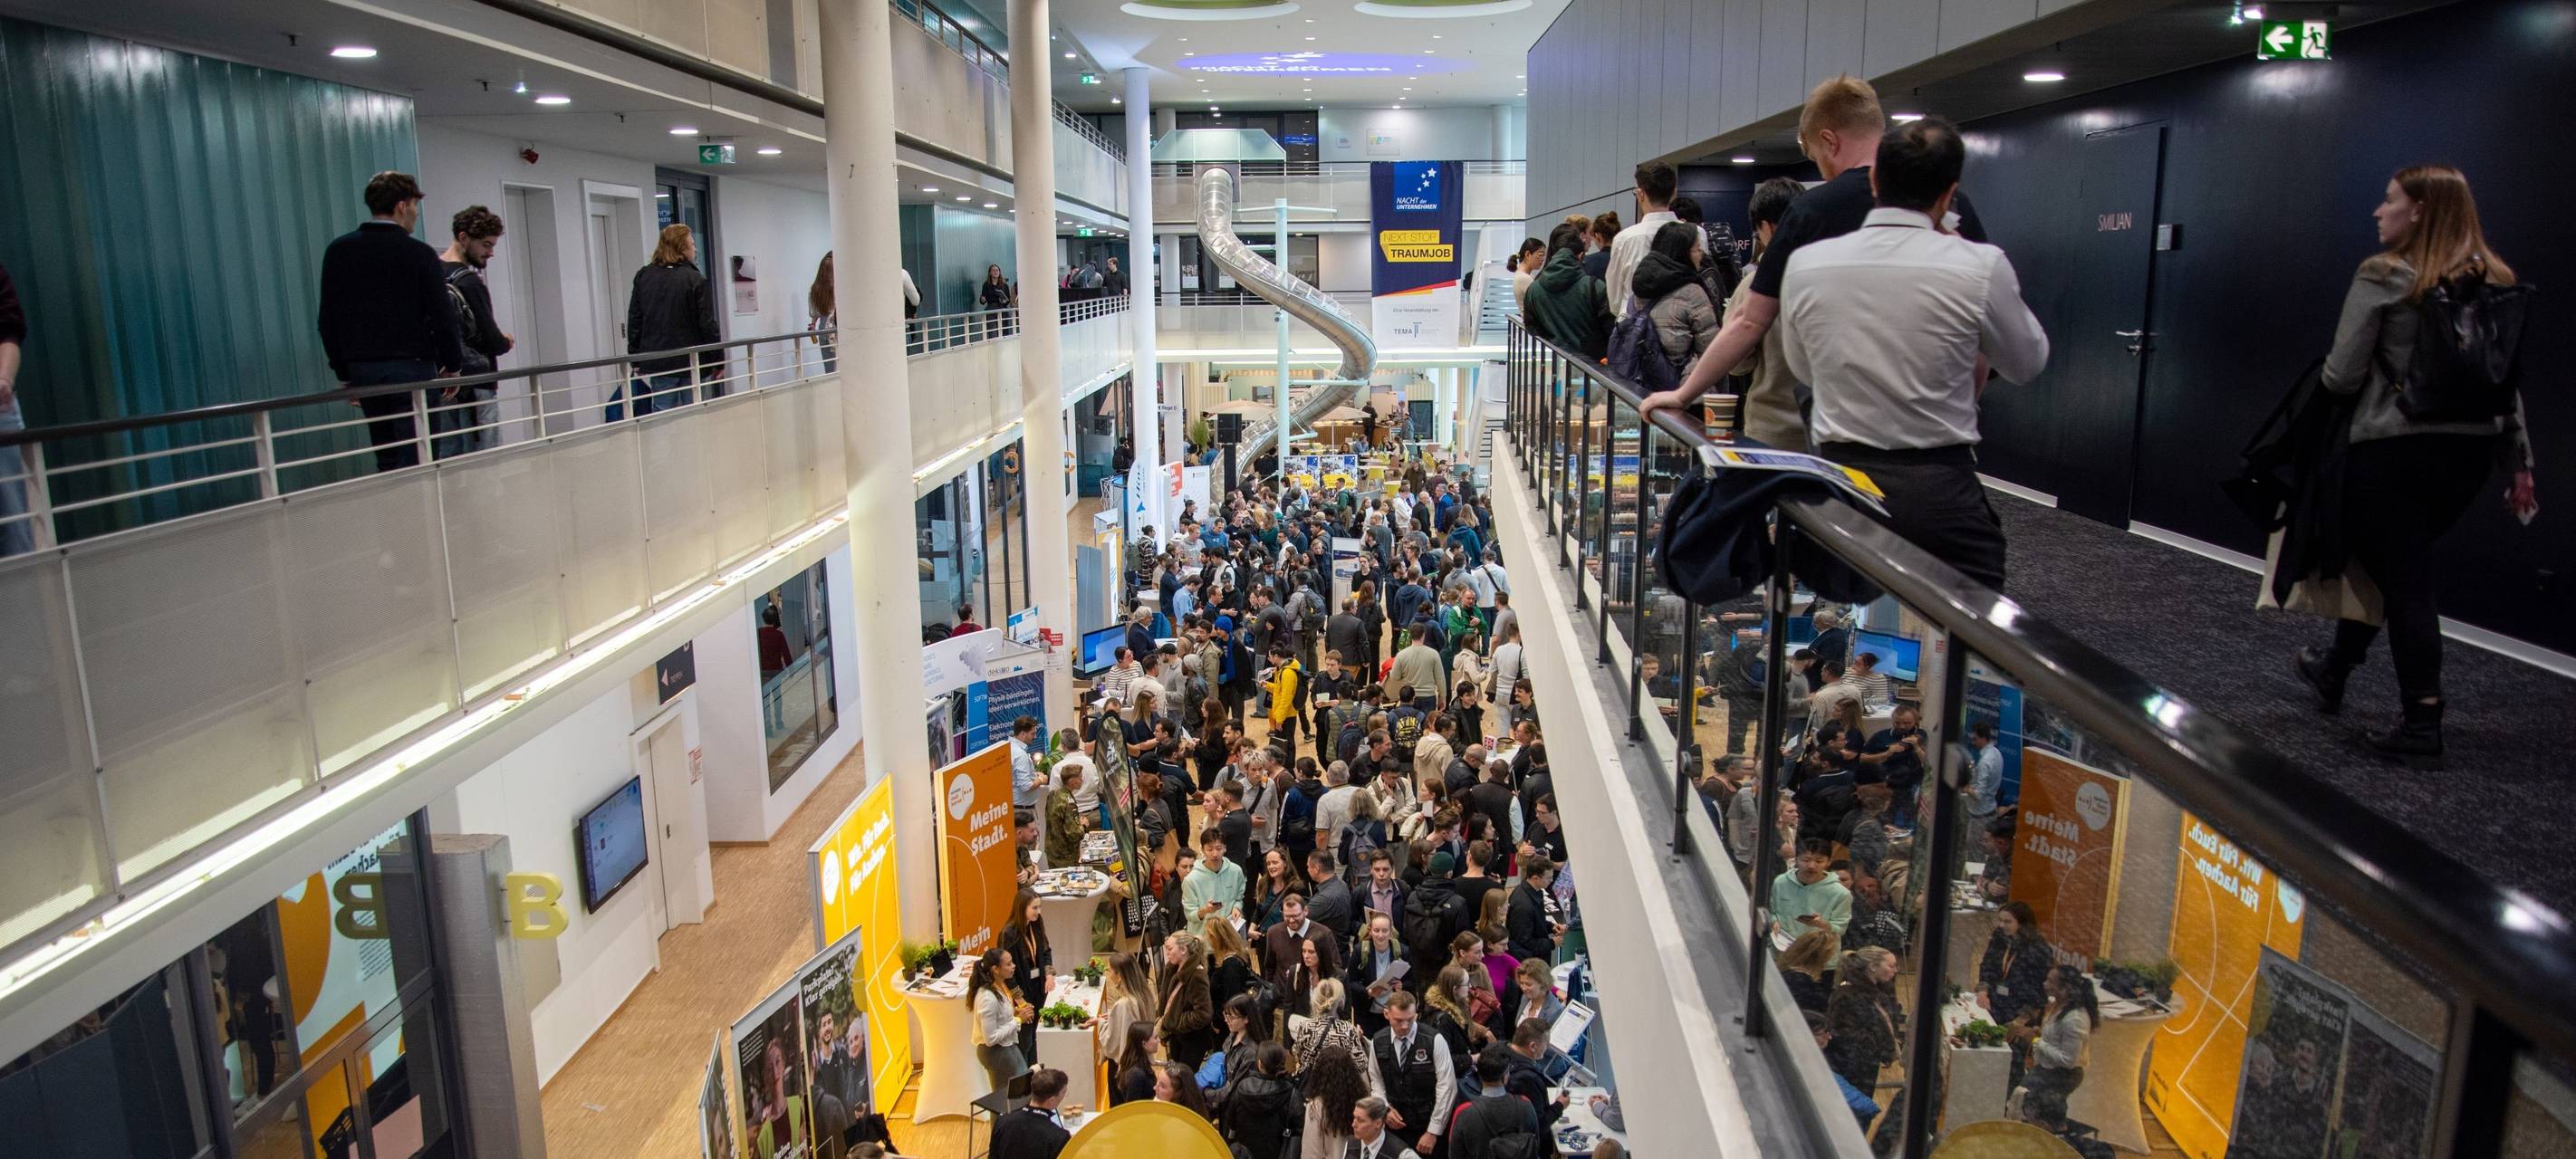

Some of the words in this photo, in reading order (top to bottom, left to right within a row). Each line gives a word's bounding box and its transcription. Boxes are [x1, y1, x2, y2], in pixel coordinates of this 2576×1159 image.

[1396, 196, 1419, 205] NACHT
[1383, 233, 1408, 242] NEXT
[1410, 233, 1437, 242] STOP
[1390, 248, 1451, 258] TRAUMJOB
[970, 801, 1008, 833] Meine
[971, 824, 1008, 857] Stadt.
[505, 872, 570, 939] B
[960, 925, 991, 955] Mein
[805, 992, 819, 1007] Klar
